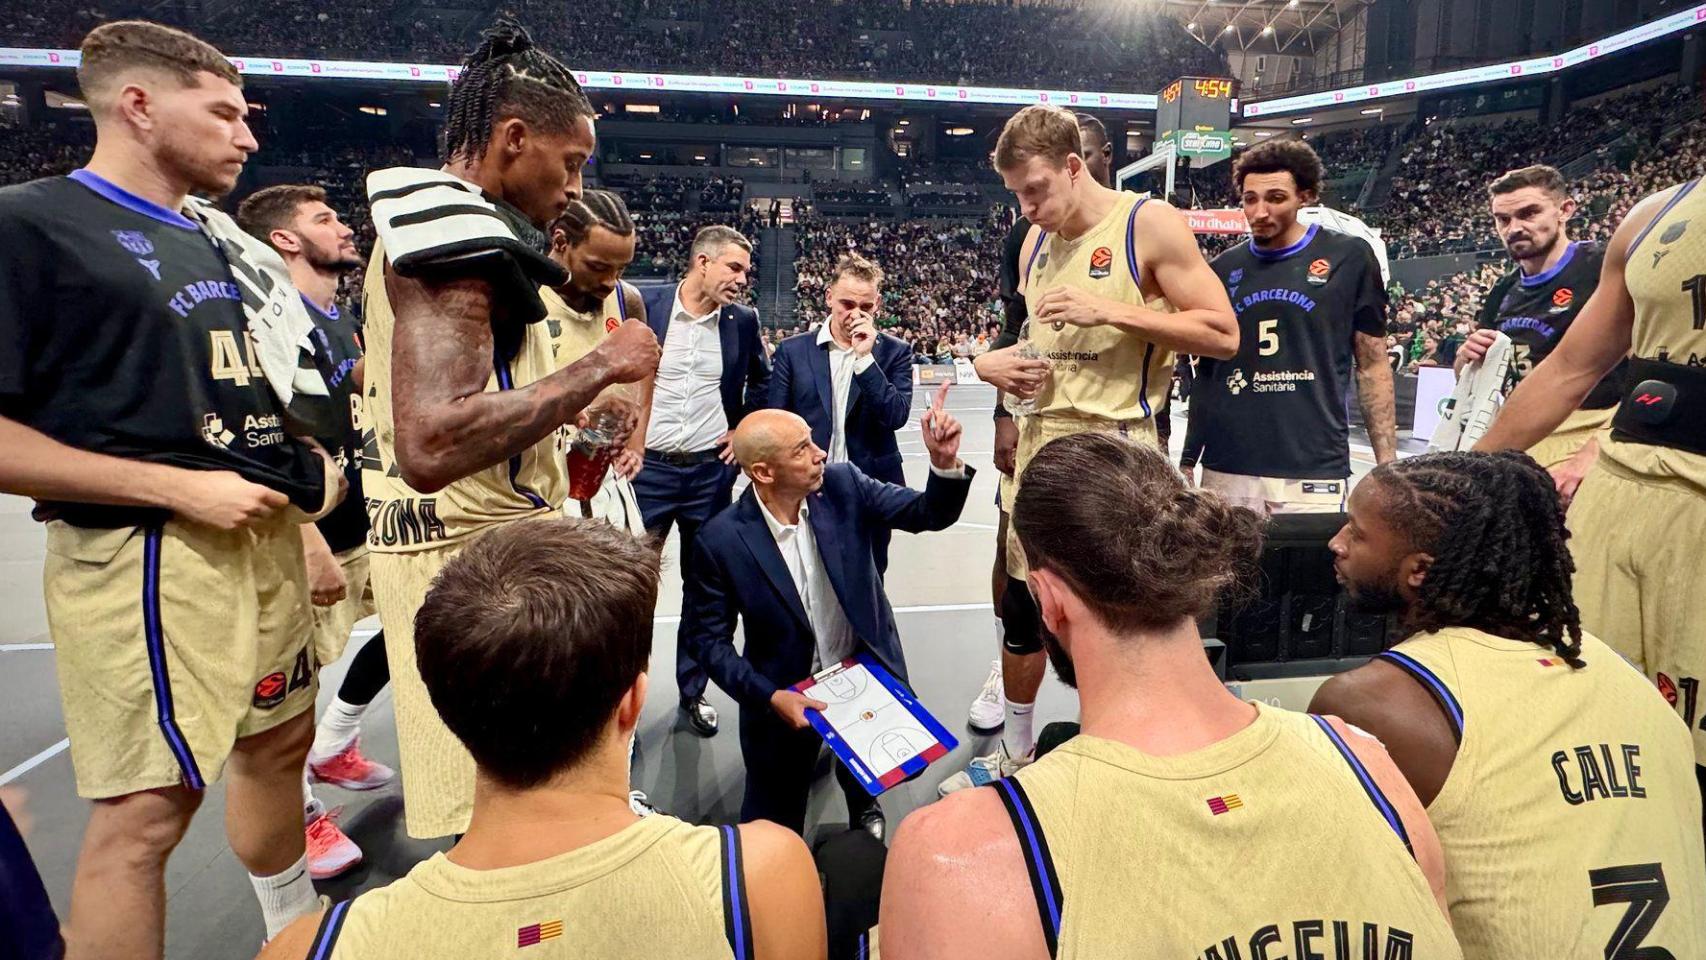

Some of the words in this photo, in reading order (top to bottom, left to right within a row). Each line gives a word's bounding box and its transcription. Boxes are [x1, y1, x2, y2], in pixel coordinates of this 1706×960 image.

[1188, 216, 1205, 228] bu
[168, 291, 194, 318] FC
[1243, 288, 1316, 312] BARCELONA
[1258, 318, 1280, 356] 5
[1253, 369, 1315, 381] Assistència
[1551, 743, 1647, 806] CALE
